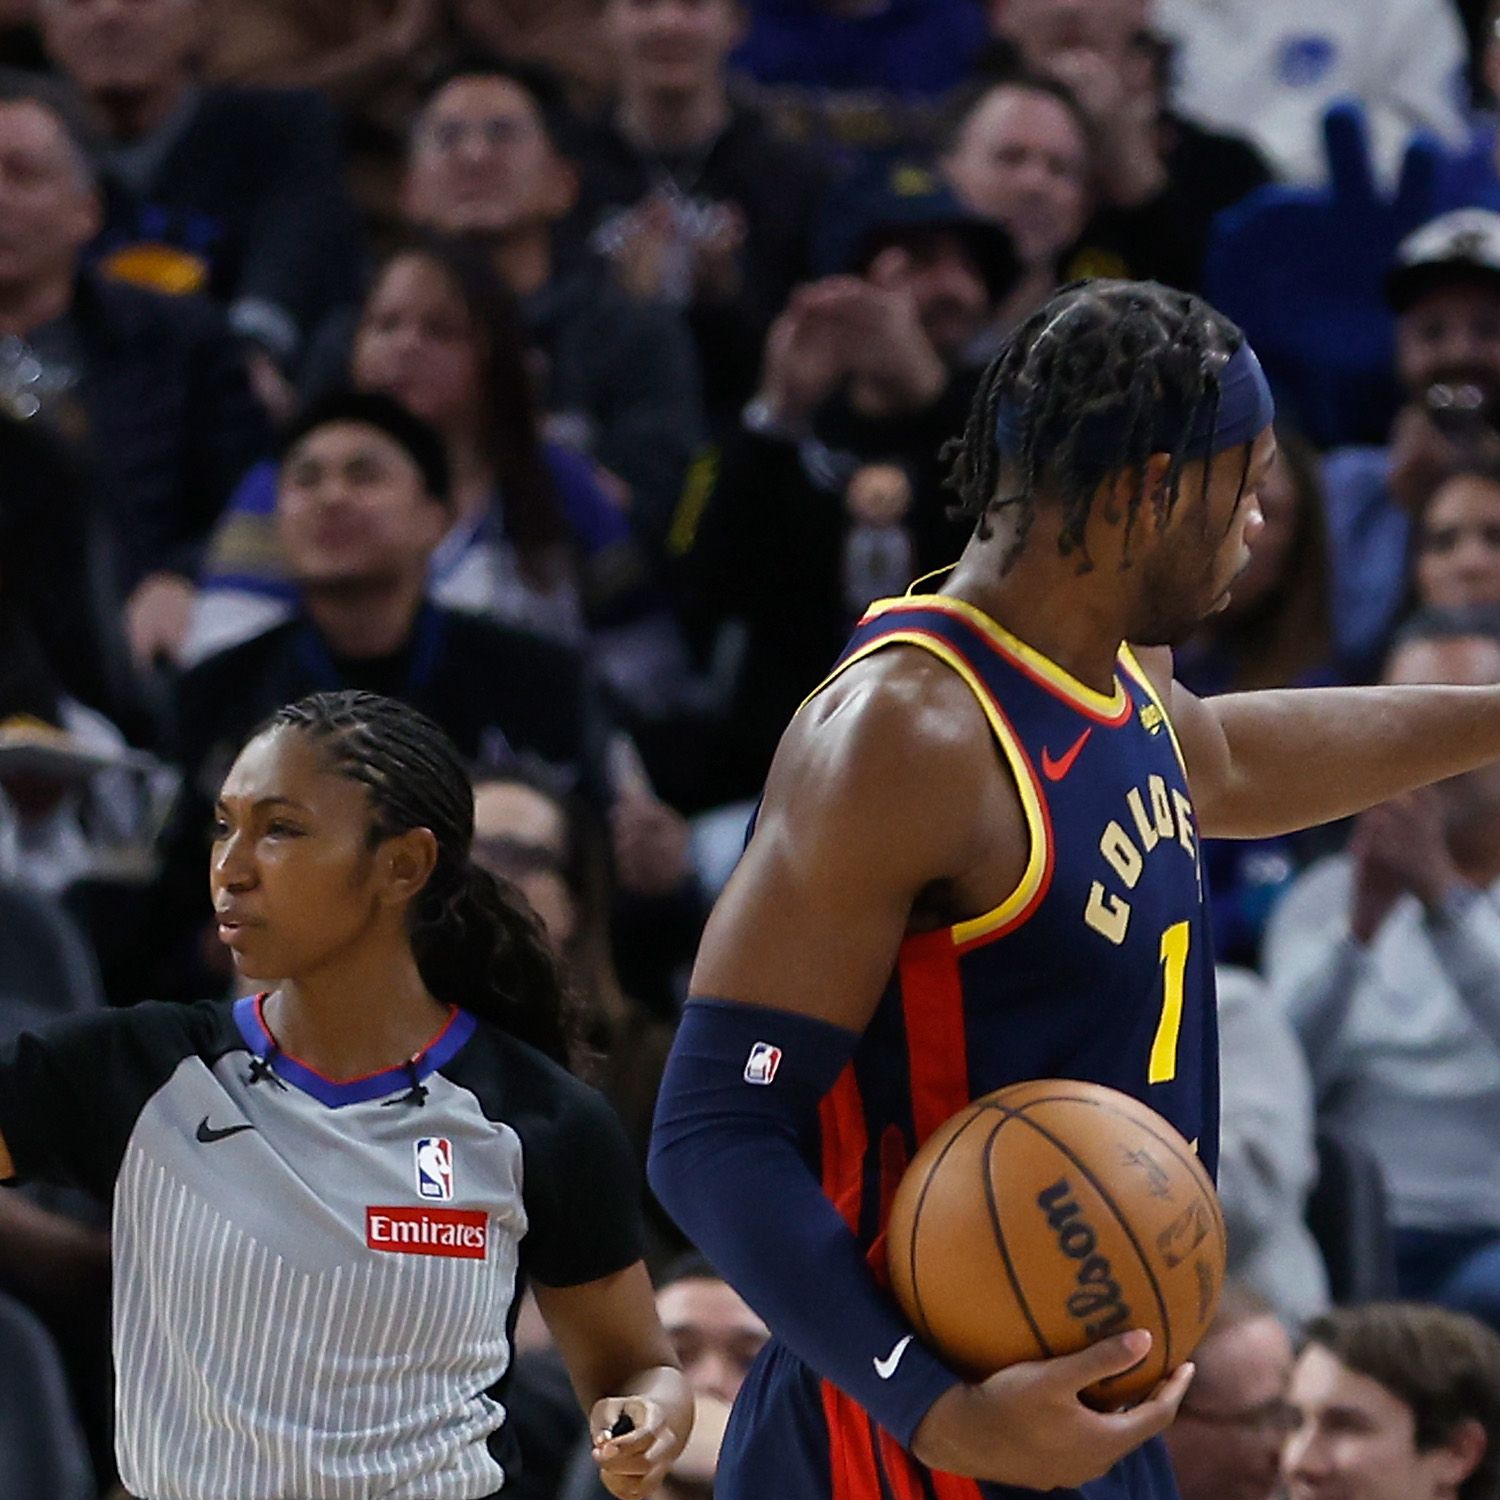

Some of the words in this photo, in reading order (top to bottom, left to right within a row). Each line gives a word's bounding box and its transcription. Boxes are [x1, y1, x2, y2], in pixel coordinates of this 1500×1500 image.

[1085, 773, 1203, 945] GOLDE
[369, 1214, 485, 1249] Emirates
[1037, 1174, 1132, 1342] ilson
